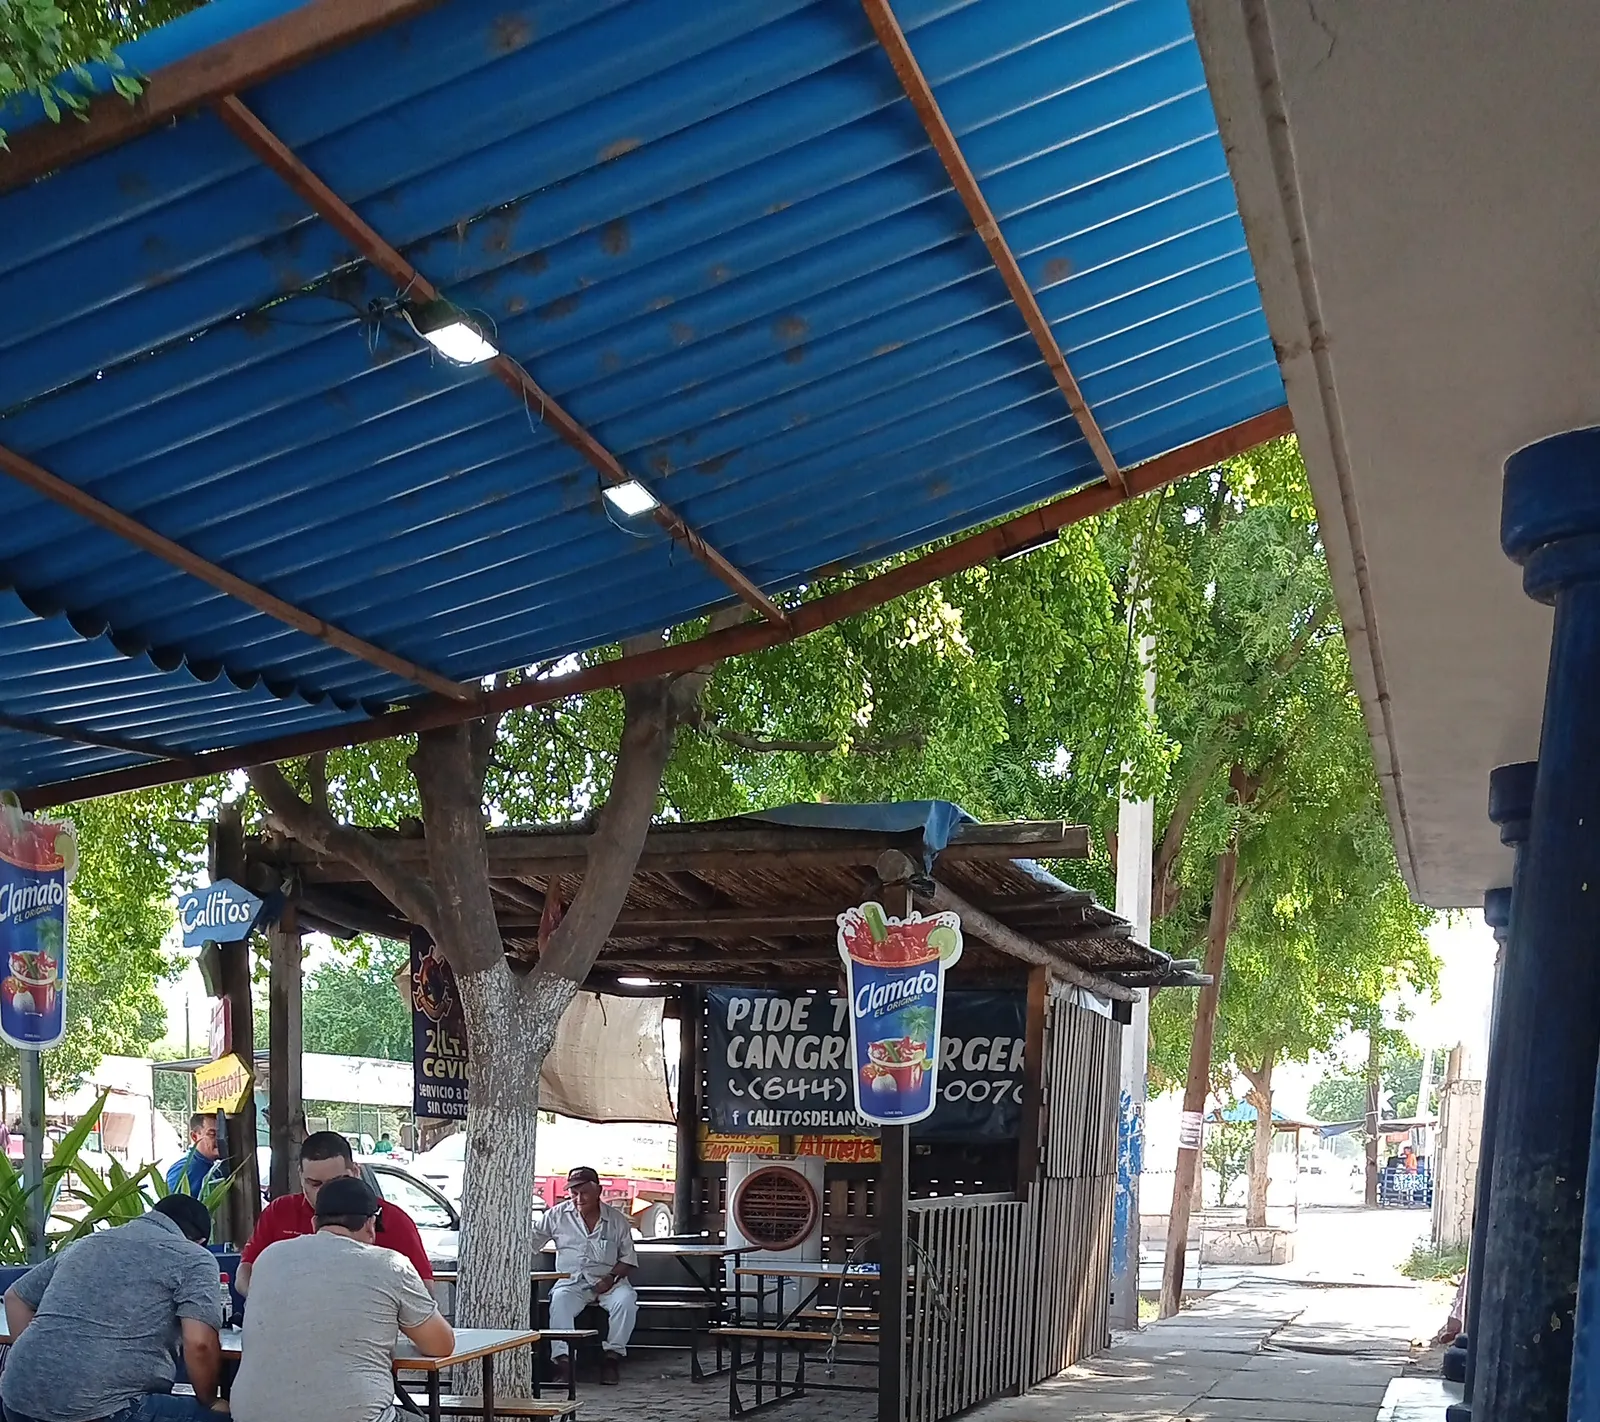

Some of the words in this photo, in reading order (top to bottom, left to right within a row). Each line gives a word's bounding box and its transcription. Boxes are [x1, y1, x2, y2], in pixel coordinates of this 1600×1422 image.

[0, 878, 63, 922] Clamato
[180, 889, 251, 934] Callitos
[855, 969, 937, 1019] Clamato
[873, 1007, 885, 1018] EL
[726, 997, 813, 1032] PIDE
[747, 1076, 848, 1101] (644)
